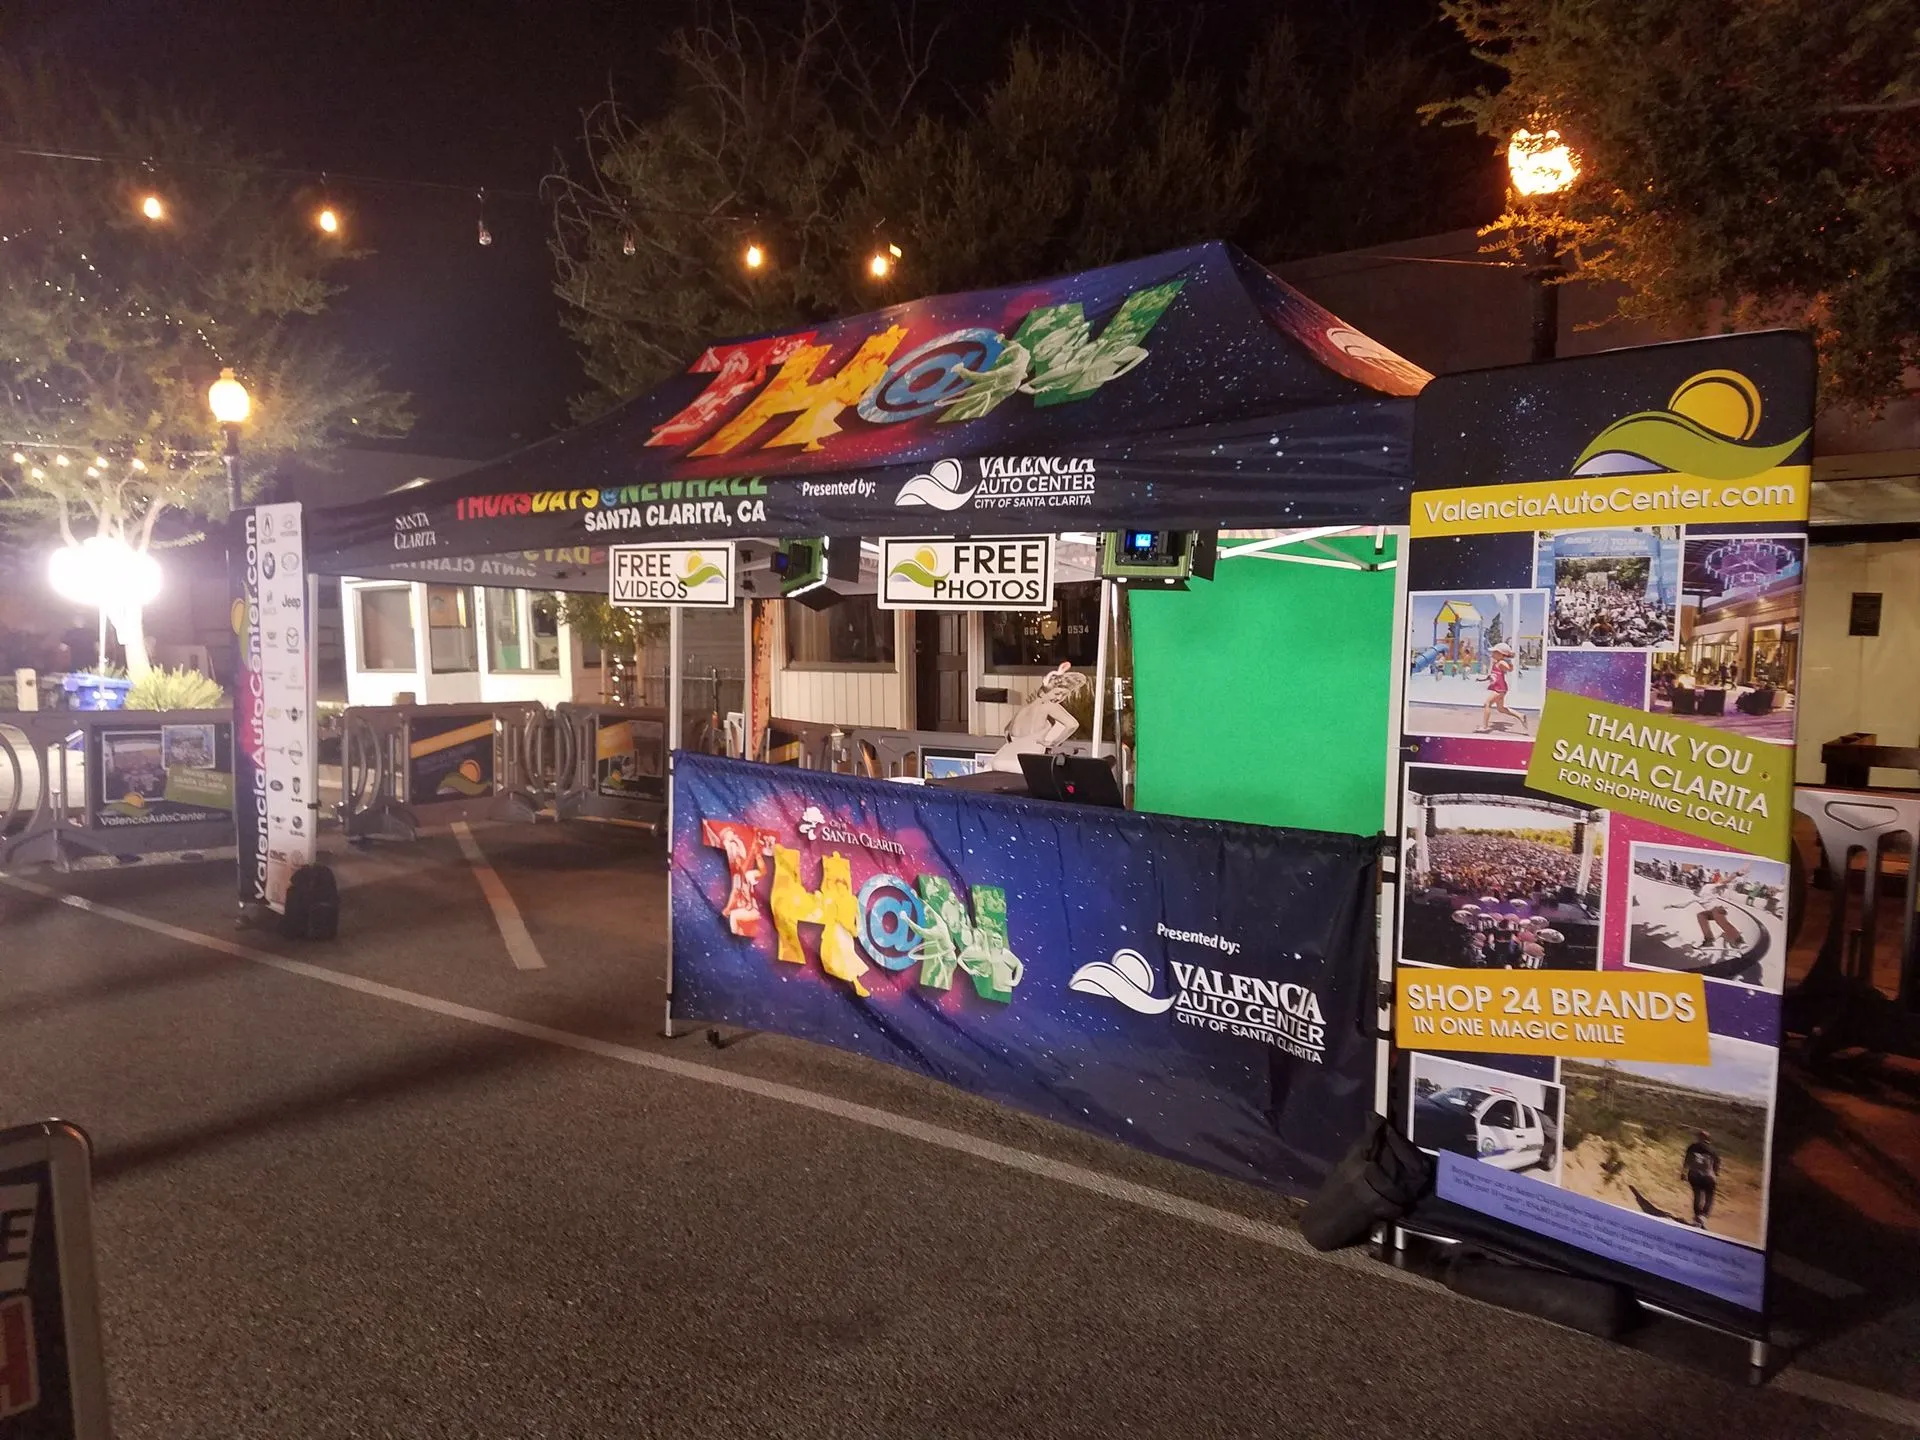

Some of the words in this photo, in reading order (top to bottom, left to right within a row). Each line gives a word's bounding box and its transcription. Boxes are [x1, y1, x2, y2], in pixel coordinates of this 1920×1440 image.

[979, 456, 1096, 478] VALENCIA
[802, 478, 858, 497] Presented
[858, 478, 876, 498] by:
[977, 477, 1022, 494] AUTO
[1026, 474, 1095, 492] CENTER
[974, 498, 996, 509] CITY
[998, 497, 1012, 508] OF
[1014, 496, 1046, 507] SANTA
[1048, 494, 1092, 506] CLARITA
[1425, 484, 1795, 523] ValenciaAutoCenter.com
[395, 512, 430, 531] SANTA
[584, 507, 641, 532] SANTA
[646, 500, 732, 527] CLARITA,
[737, 500, 767, 523] CA
[394, 531, 436, 550] CLARITA
[617, 554, 671, 577] FREE
[954, 544, 1039, 574] FREE
[282, 594, 301, 610] Jeep
[616, 580, 688, 598] VIDEOS
[933, 580, 1040, 600] PHOTOS
[1067, 625, 1089, 634] 0534
[245, 514, 268, 900] ValenciaAutoCenter.com
[1588, 713, 1681, 757] THANK
[1688, 737, 1754, 776] YOU
[1552, 739, 1640, 782] SANTA
[1650, 765, 1769, 818] CLARITA
[1558, 768, 1592, 788] FOR
[1594, 777, 1682, 814] SHOPPING
[1686, 802, 1753, 835] LOCAL!
[100, 811, 227, 826] ValenciaAutoCenter
[821, 827, 860, 845] SANTA
[859, 832, 906, 855] CLARITA
[1157, 922, 1218, 949] Presented
[1219, 936, 1241, 955] by:
[1170, 960, 1327, 1025] VALENCIA
[1407, 984, 1493, 1013] SHOP
[1501, 987, 1541, 1015] 24
[1551, 988, 1697, 1022] BRANDS
[1177, 990, 1240, 1018] AUTO
[1245, 1005, 1325, 1045] CENTER
[1413, 1017, 1436, 1034] IN
[1439, 1017, 1484, 1036] ONE
[1489, 1019, 1569, 1041] MAGIC
[1575, 1024, 1626, 1045] MILE
[1177, 1013, 1206, 1028] CITY
[1208, 1020, 1228, 1033] OF
[1231, 1024, 1275, 1046] SANTA
[1276, 1036, 1323, 1065] CLARITA
